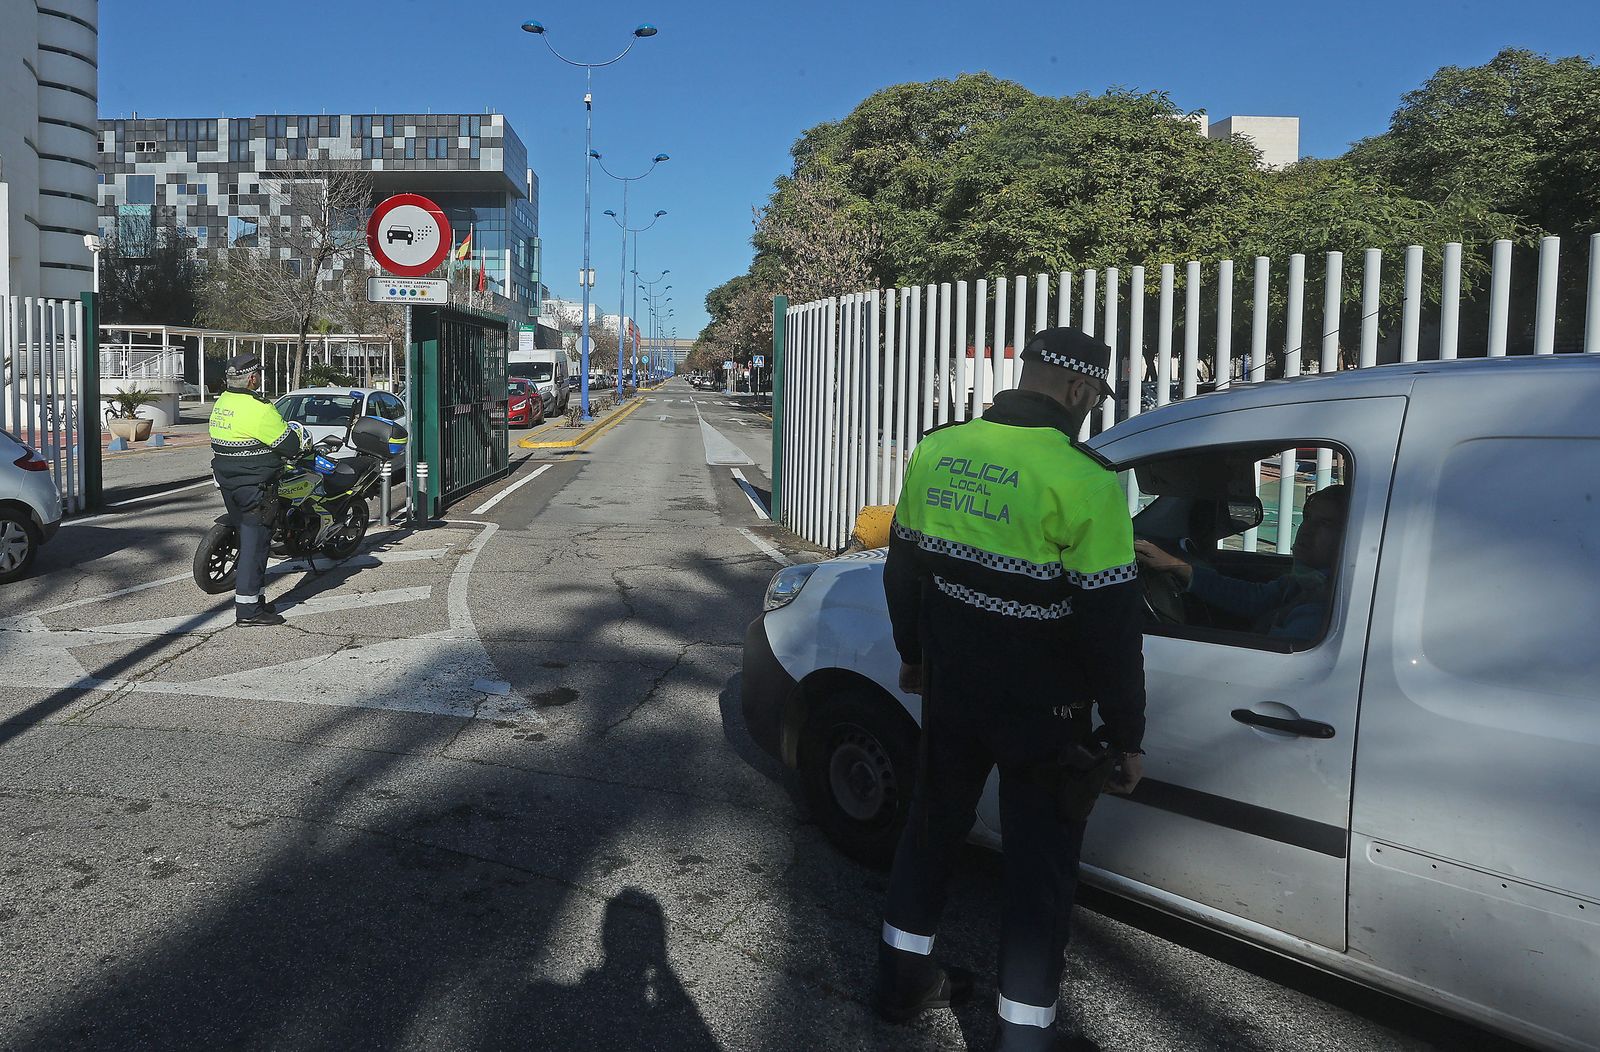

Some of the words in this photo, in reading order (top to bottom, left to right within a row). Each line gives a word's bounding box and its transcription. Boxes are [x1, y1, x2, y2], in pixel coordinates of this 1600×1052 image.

[935, 456, 1018, 488] POLICIA
[950, 478, 992, 496] LOCAL
[926, 488, 1010, 524] SEVILLA
